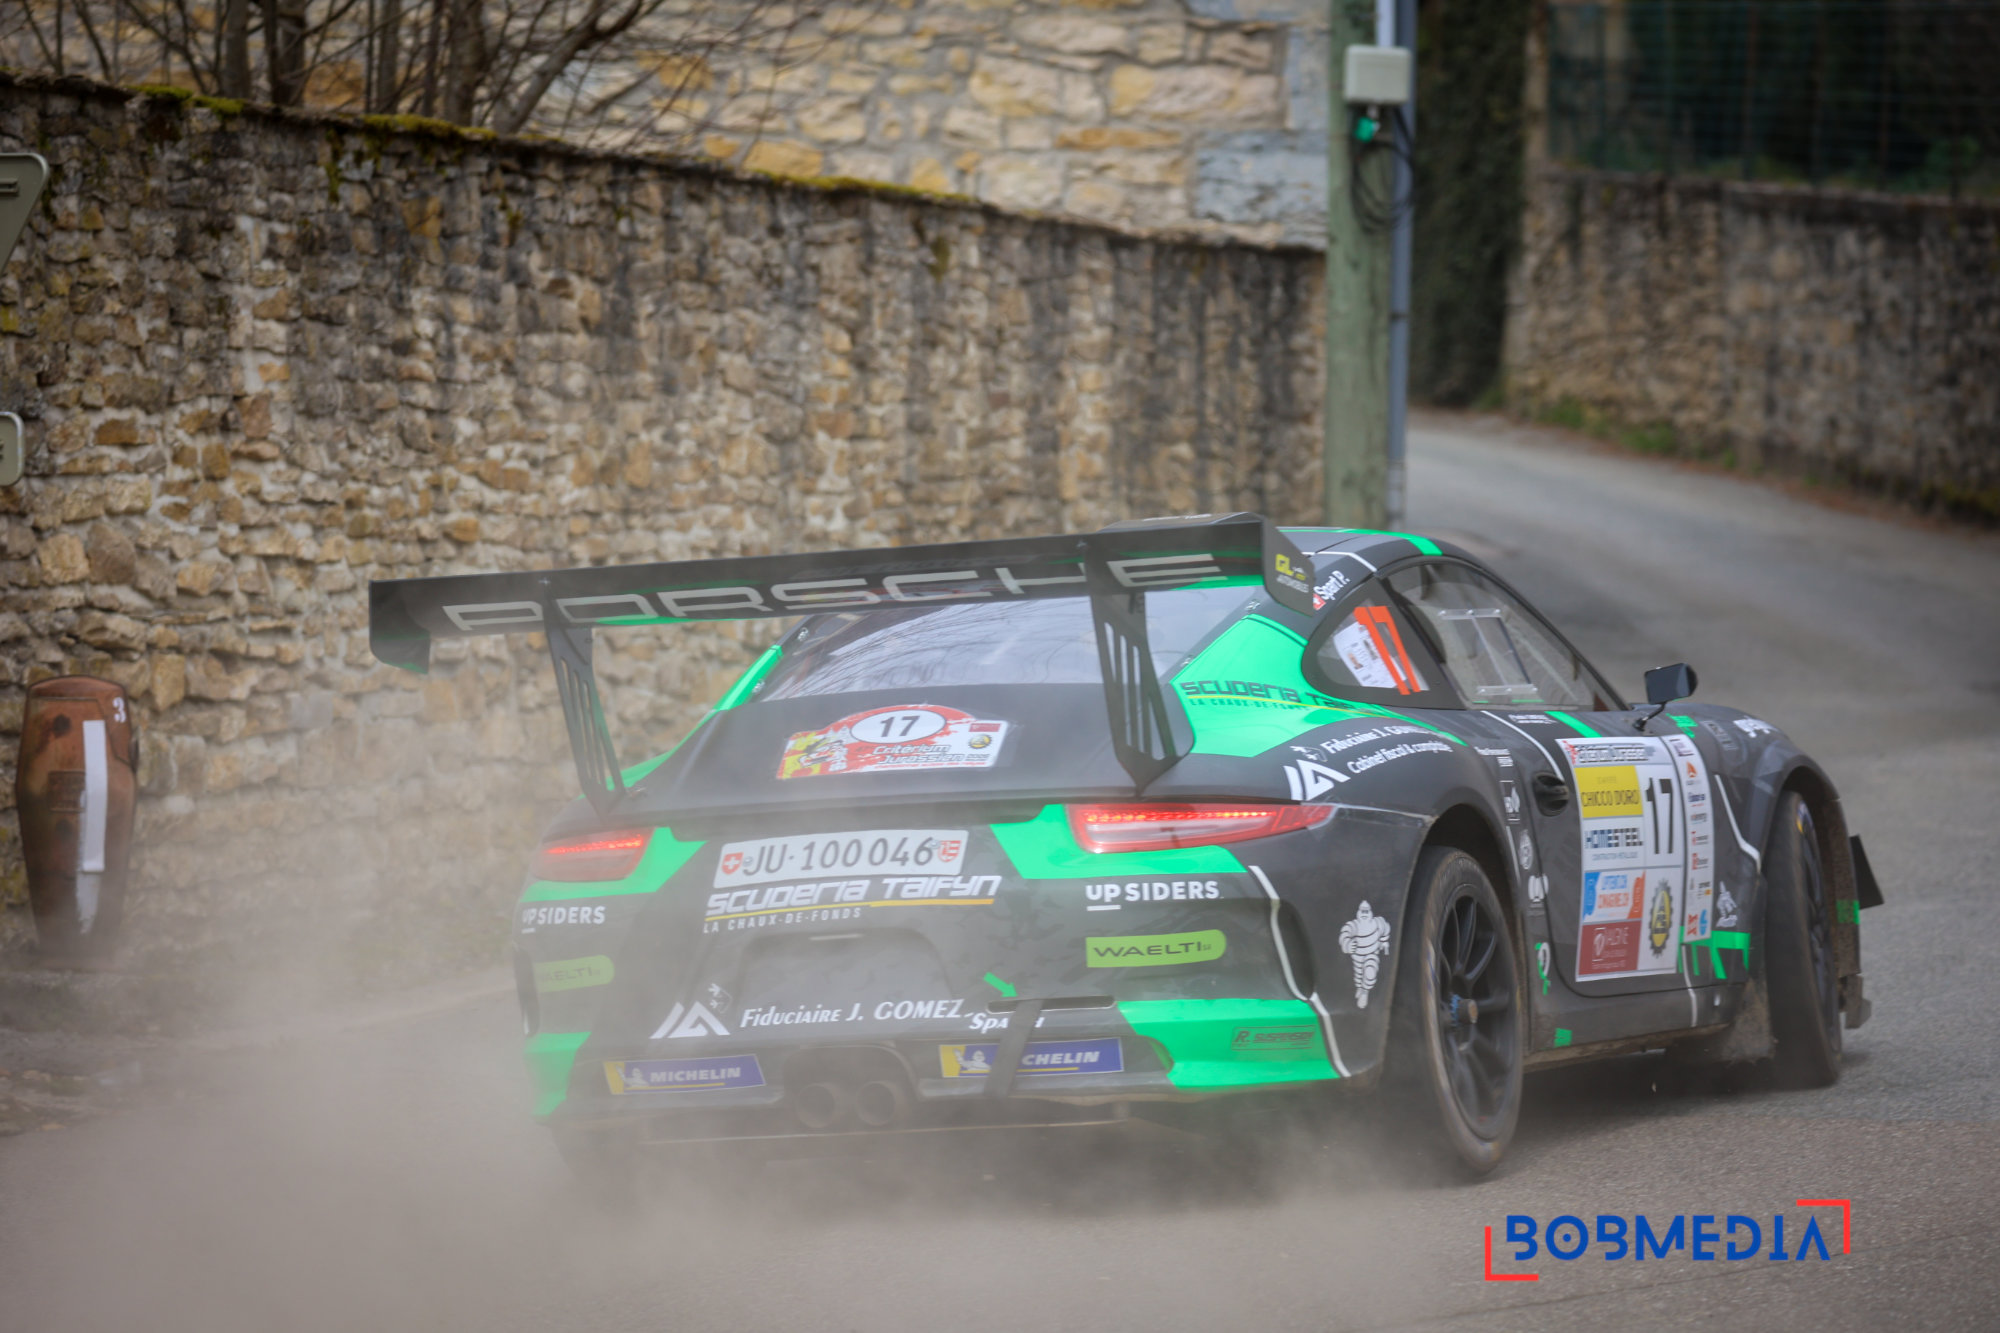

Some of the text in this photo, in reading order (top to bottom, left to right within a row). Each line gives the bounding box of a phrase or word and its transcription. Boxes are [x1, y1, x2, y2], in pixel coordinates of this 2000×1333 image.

[443, 554, 1228, 631] PORSCHE
[113, 696, 127, 724] 3
[880, 715, 920, 738] 17
[1645, 776, 1674, 855] 17
[703, 907, 862, 934] LA CHAUX-DE-FONDS
[1093, 941, 1202, 957] WAELTI
[845, 1002, 864, 1022] J.
[873, 999, 965, 1021] GOMEZ
[1021, 1051, 1100, 1067] CHELIN
[650, 1066, 742, 1083] MICHELIN
